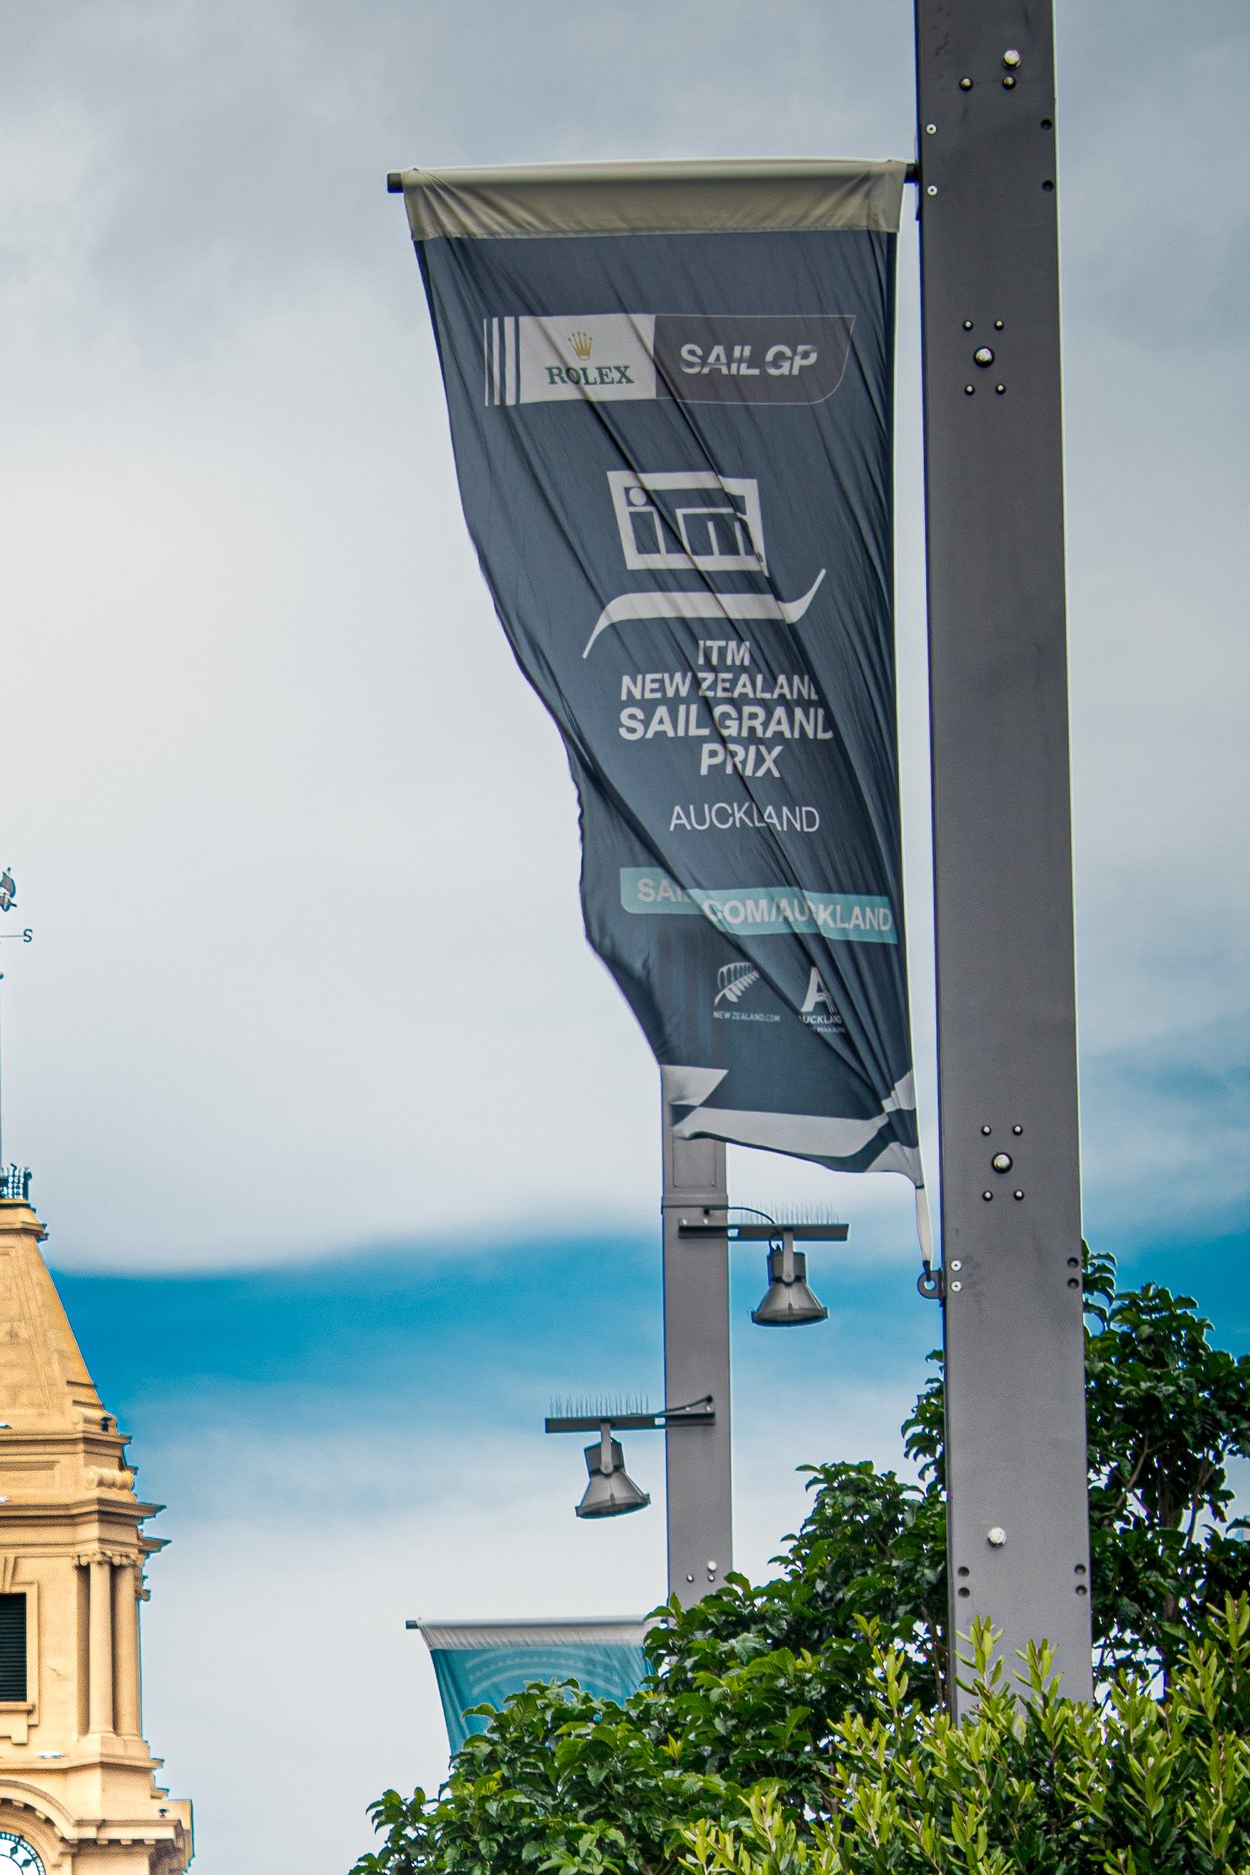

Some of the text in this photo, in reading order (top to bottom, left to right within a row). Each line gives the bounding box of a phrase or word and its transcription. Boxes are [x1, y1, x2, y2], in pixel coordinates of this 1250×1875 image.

[545, 365, 635, 386] ROLEX
[698, 640, 751, 667] ITM
[620, 671, 693, 701] NEW
[618, 703, 710, 741] SAIL
[700, 742, 784, 778] PRIX
[668, 801, 821, 833] AUCKLAND
[22, 928, 33, 943] S
